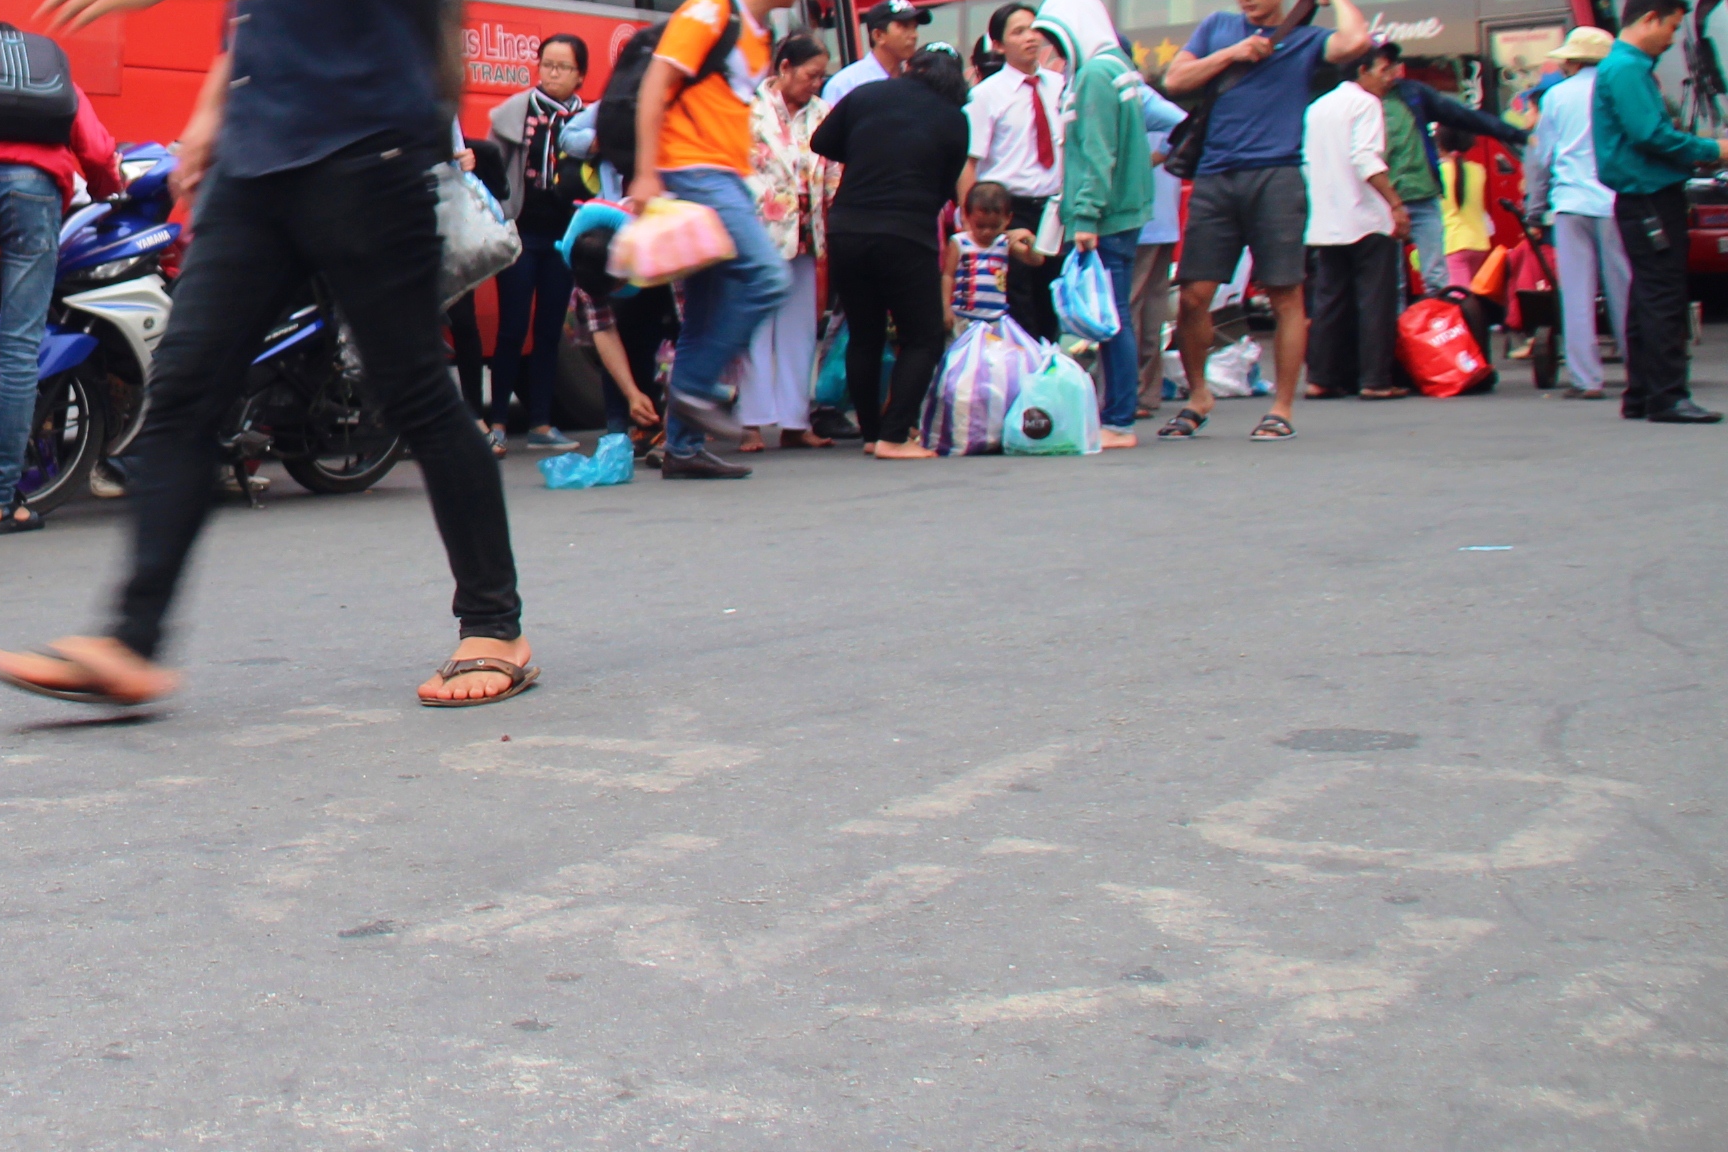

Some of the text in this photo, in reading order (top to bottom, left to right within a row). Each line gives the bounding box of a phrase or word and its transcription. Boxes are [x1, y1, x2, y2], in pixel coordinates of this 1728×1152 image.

[482, 22, 542, 64] Lines
[468, 62, 531, 86] TRANG
[135, 229, 171, 249] YAMAHA
